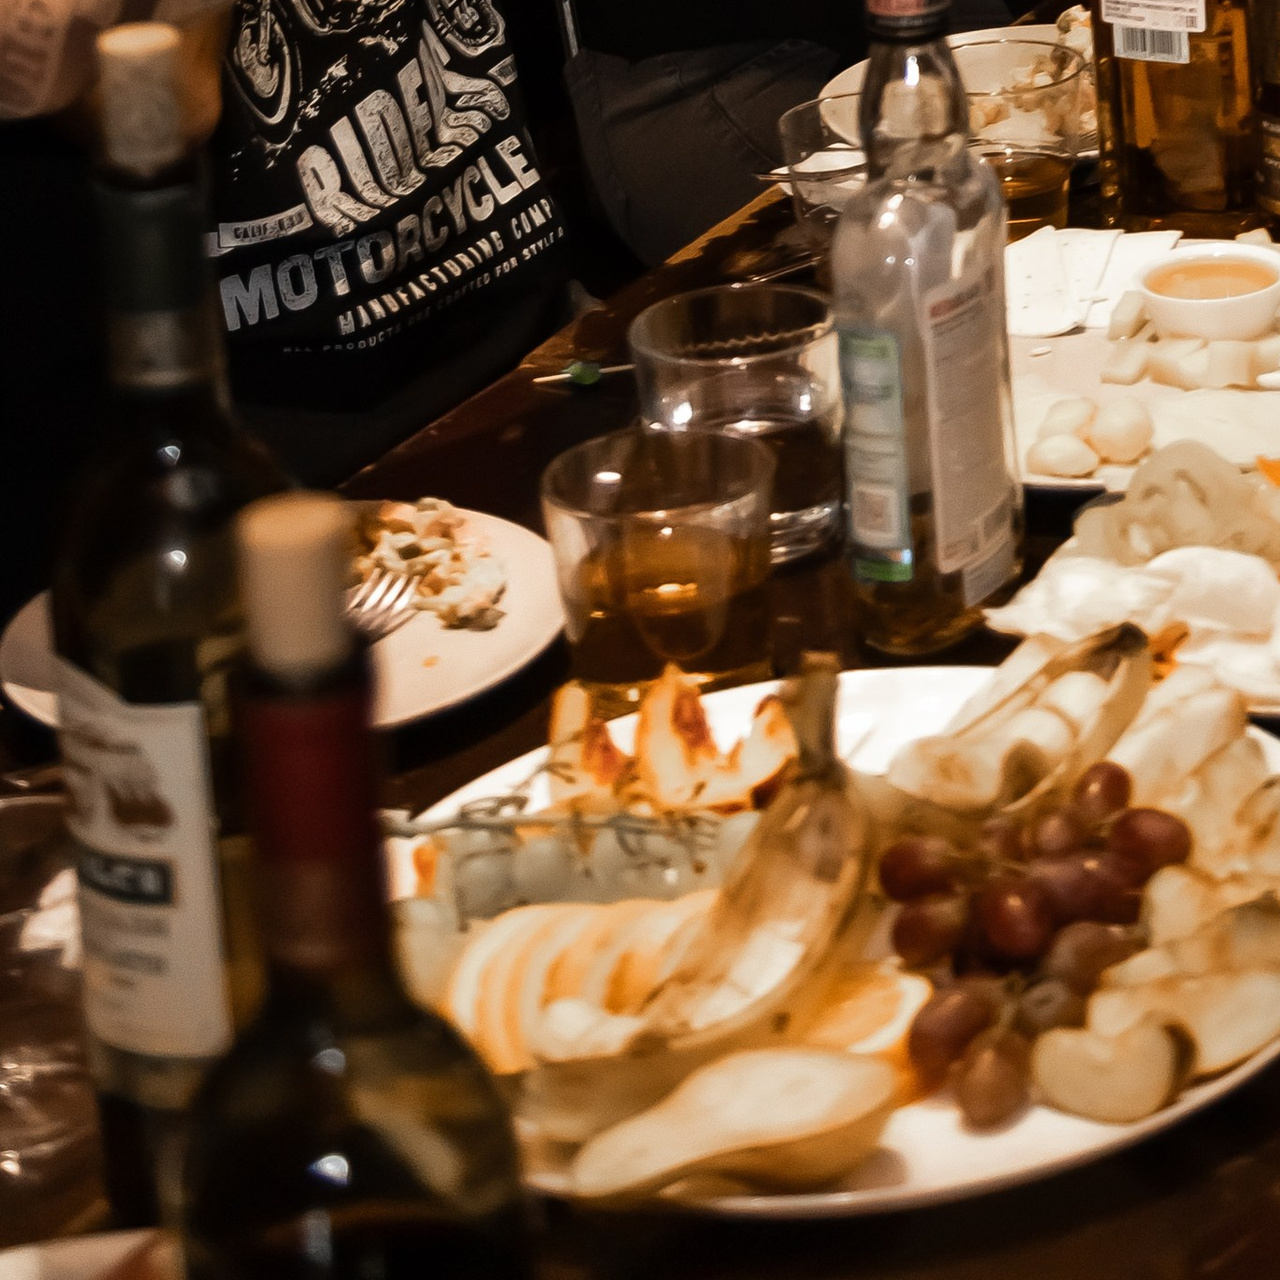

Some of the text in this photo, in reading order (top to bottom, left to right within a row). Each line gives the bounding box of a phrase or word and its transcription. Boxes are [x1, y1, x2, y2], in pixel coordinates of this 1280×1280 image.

[296, 19, 511, 238] RIDERS
[219, 134, 541, 332] MOTORCYCLE
[337, 197, 557, 336] MANUFACTURING COMP
[496, 256, 519, 278] FOR
[522, 231, 555, 261] STYLE
